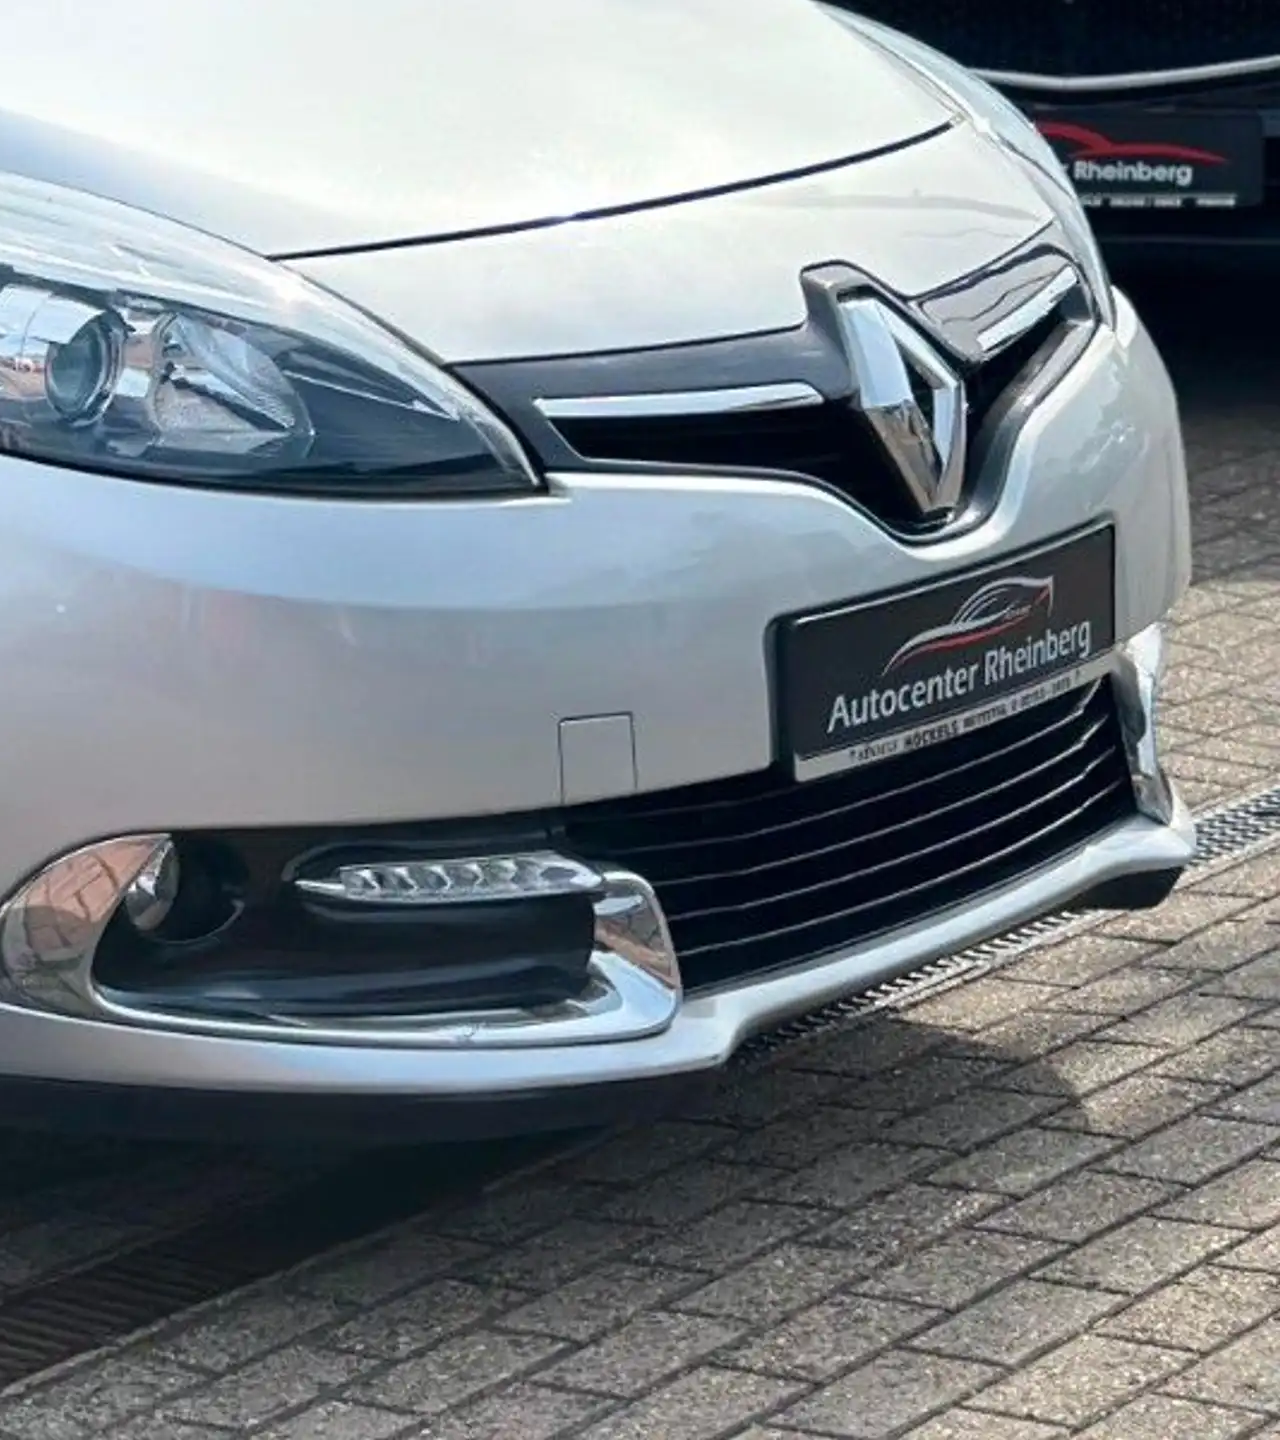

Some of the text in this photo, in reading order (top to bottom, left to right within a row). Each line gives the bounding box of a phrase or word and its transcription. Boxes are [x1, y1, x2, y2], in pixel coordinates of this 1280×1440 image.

[1073, 160, 1193, 186] Rheinberg
[826, 663, 979, 734] Autocenter
[984, 620, 1092, 686] Rheinberg
